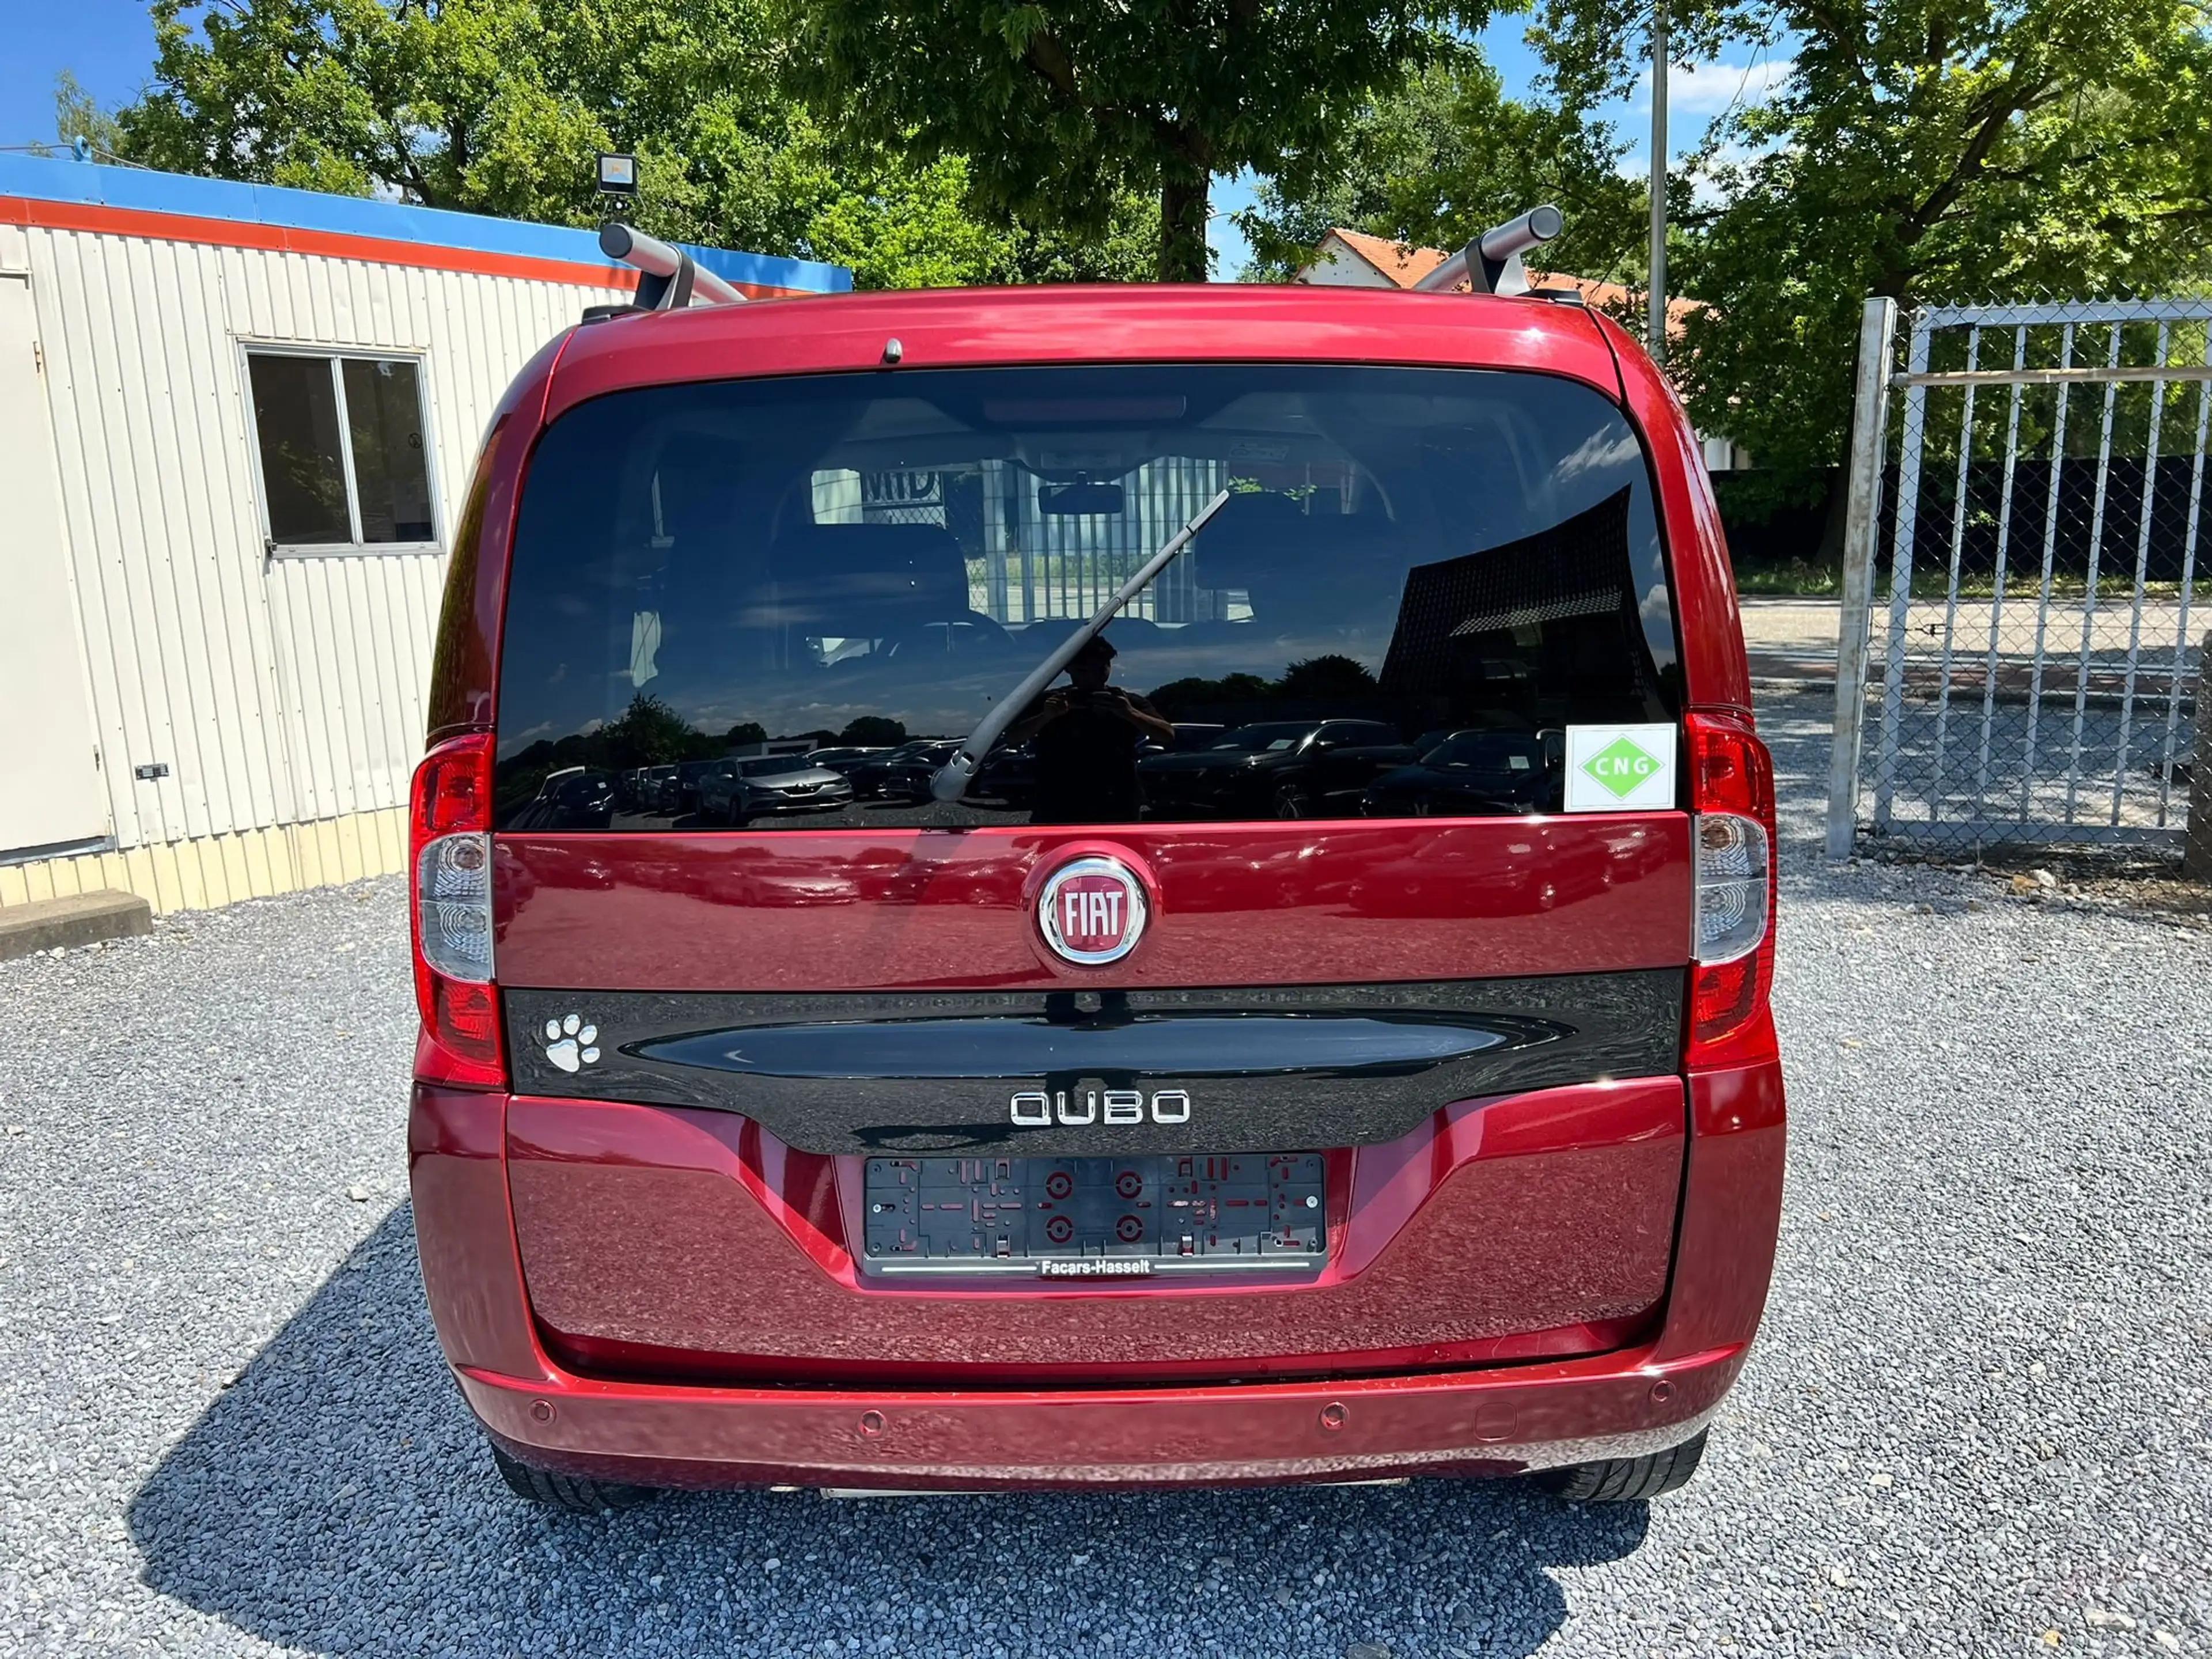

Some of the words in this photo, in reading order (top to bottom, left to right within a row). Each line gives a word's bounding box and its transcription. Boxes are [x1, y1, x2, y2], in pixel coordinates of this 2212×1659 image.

[1594, 756, 1650, 775] CNG
[1065, 891, 1123, 937] FIAT
[1010, 1089, 1191, 1126] QUBO
[1041, 1259, 1150, 1275] Facars-Hasselt
